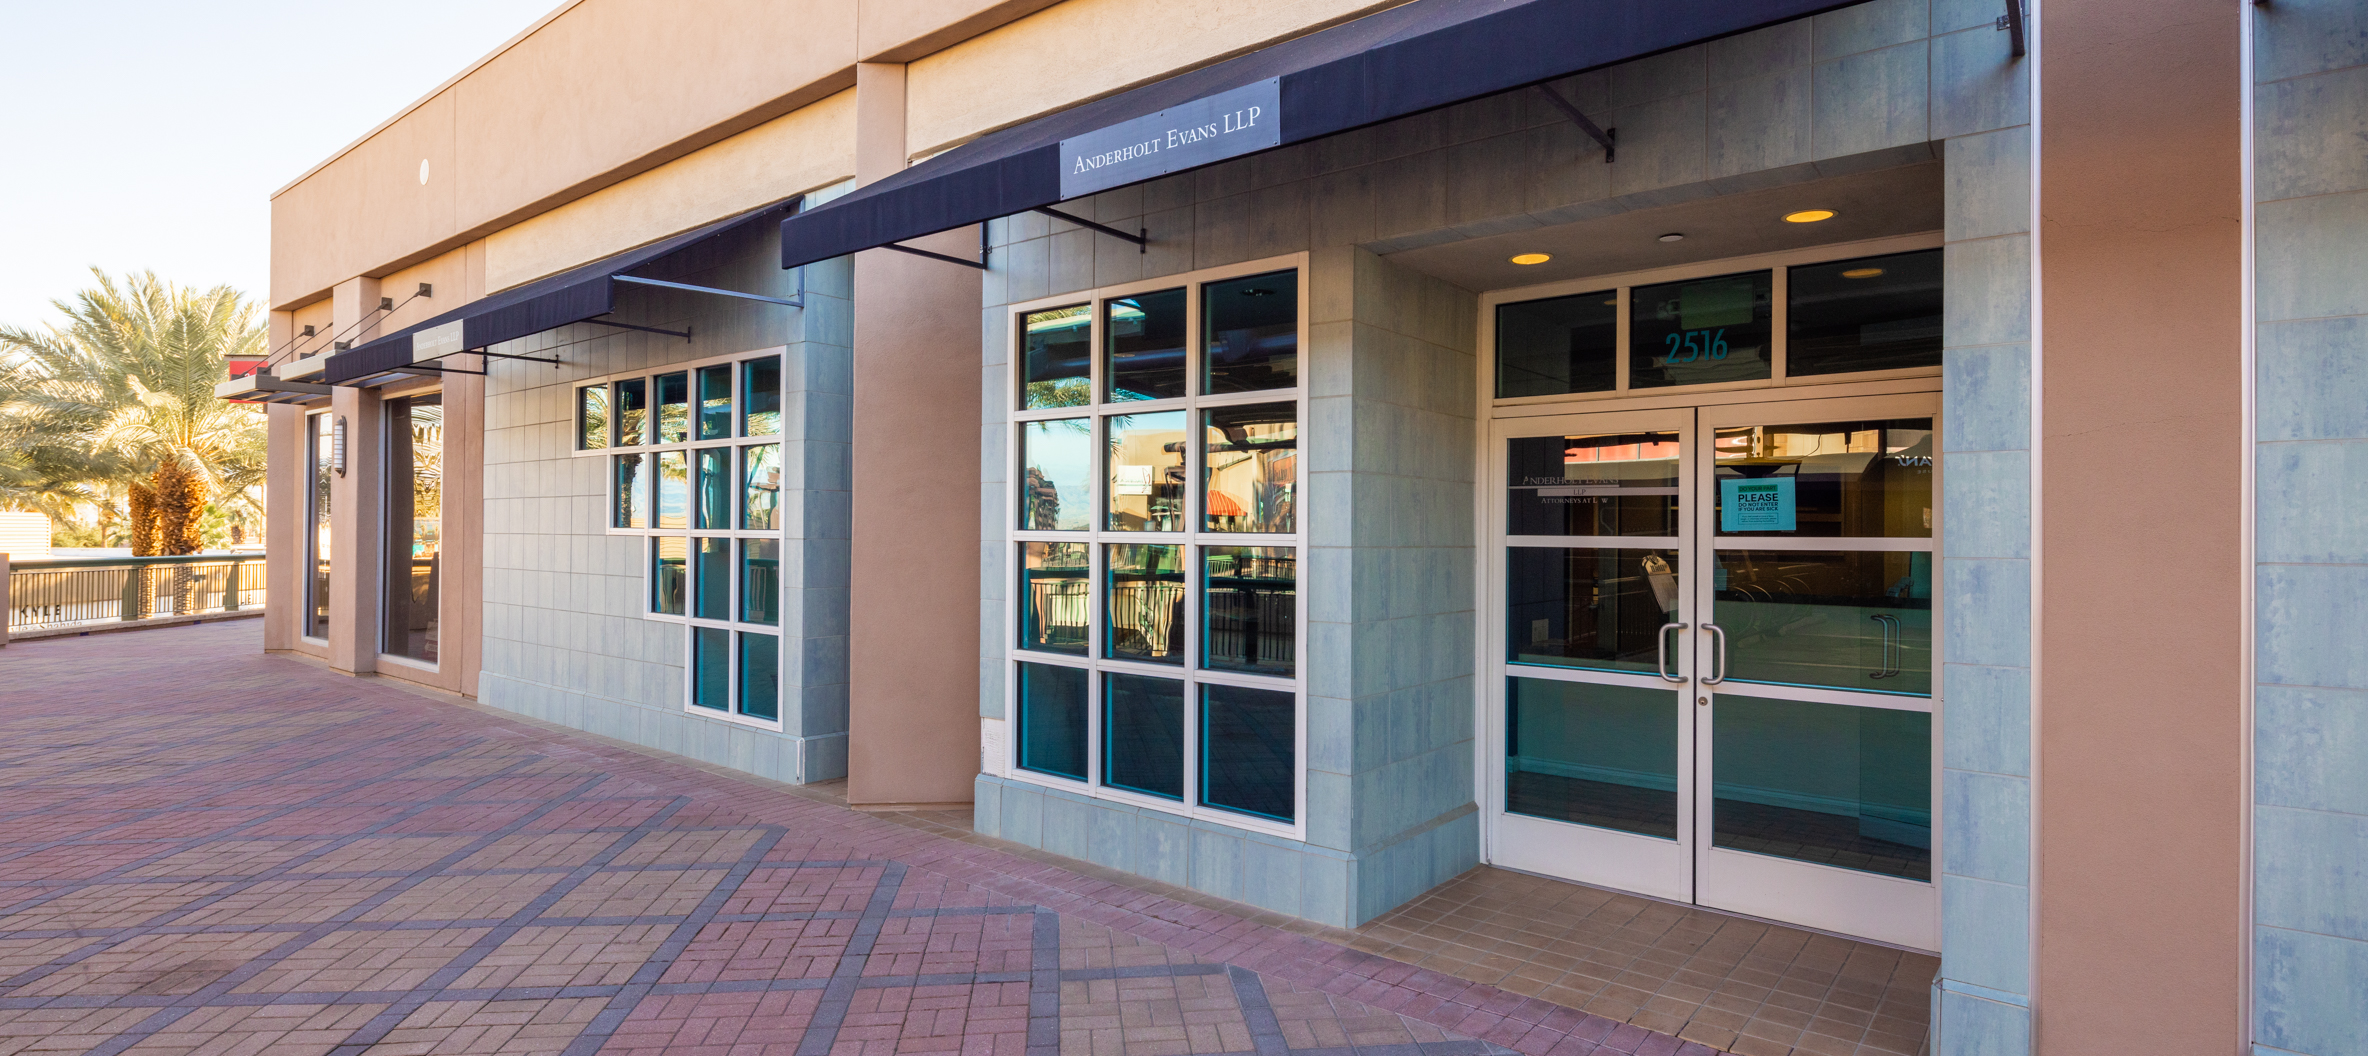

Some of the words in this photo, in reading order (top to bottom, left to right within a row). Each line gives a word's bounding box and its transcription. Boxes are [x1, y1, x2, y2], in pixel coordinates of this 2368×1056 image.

[1223, 106, 1261, 134] LLP
[1665, 329, 1728, 364] 2516
[1573, 488, 1586, 496] LLP
[1738, 493, 1778, 502] PLEASE
[20, 605, 60, 617] KYLE
